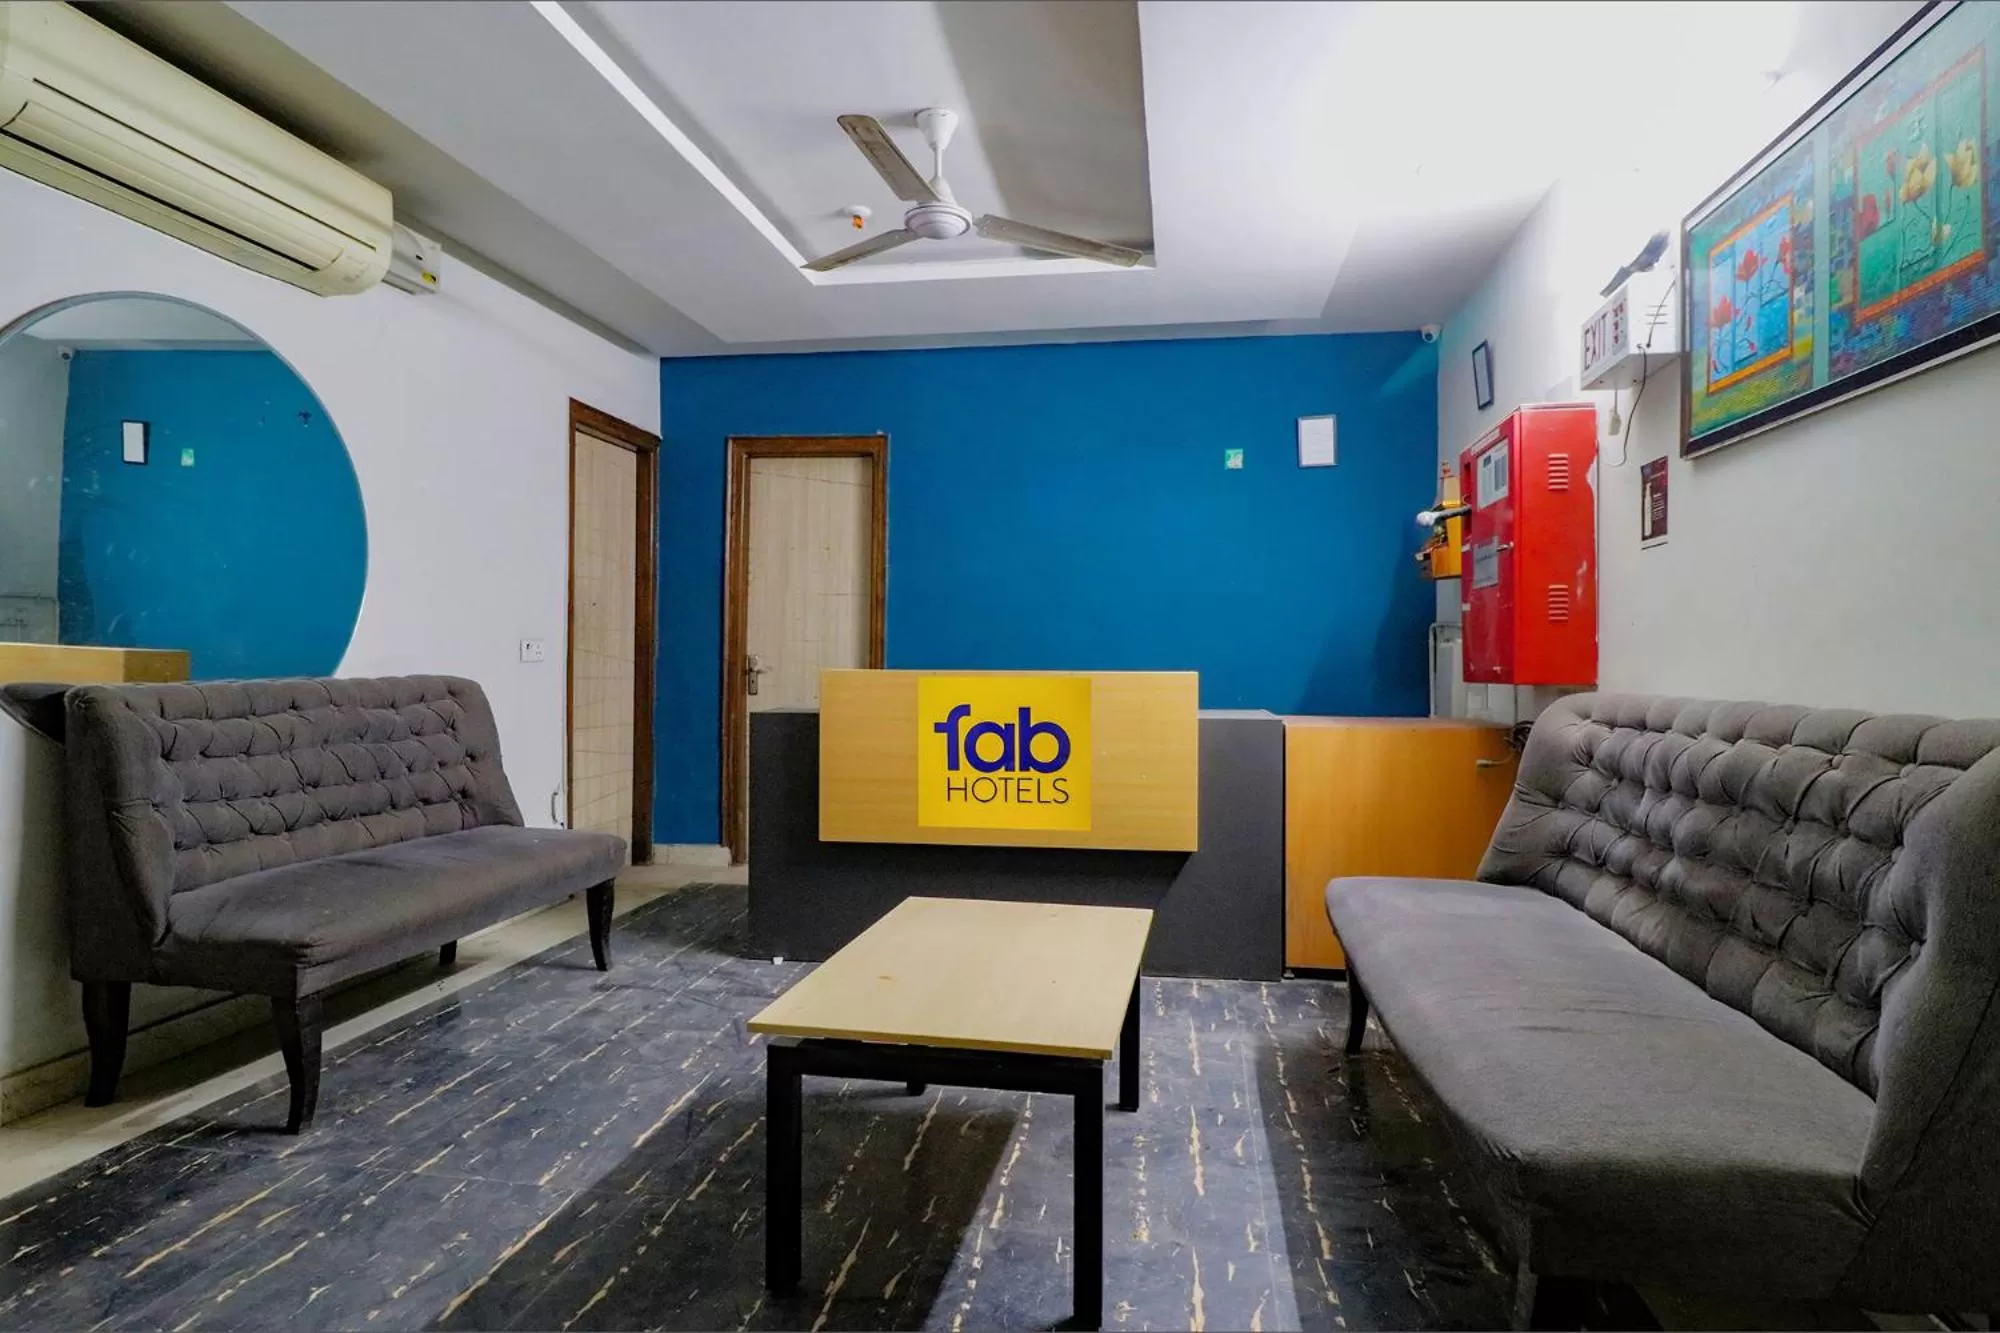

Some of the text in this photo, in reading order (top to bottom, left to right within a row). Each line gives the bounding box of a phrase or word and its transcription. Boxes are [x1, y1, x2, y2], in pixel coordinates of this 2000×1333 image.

[1584, 311, 1609, 371] EXIT
[934, 704, 1071, 773] fab
[947, 777, 1069, 804] HOTELS
